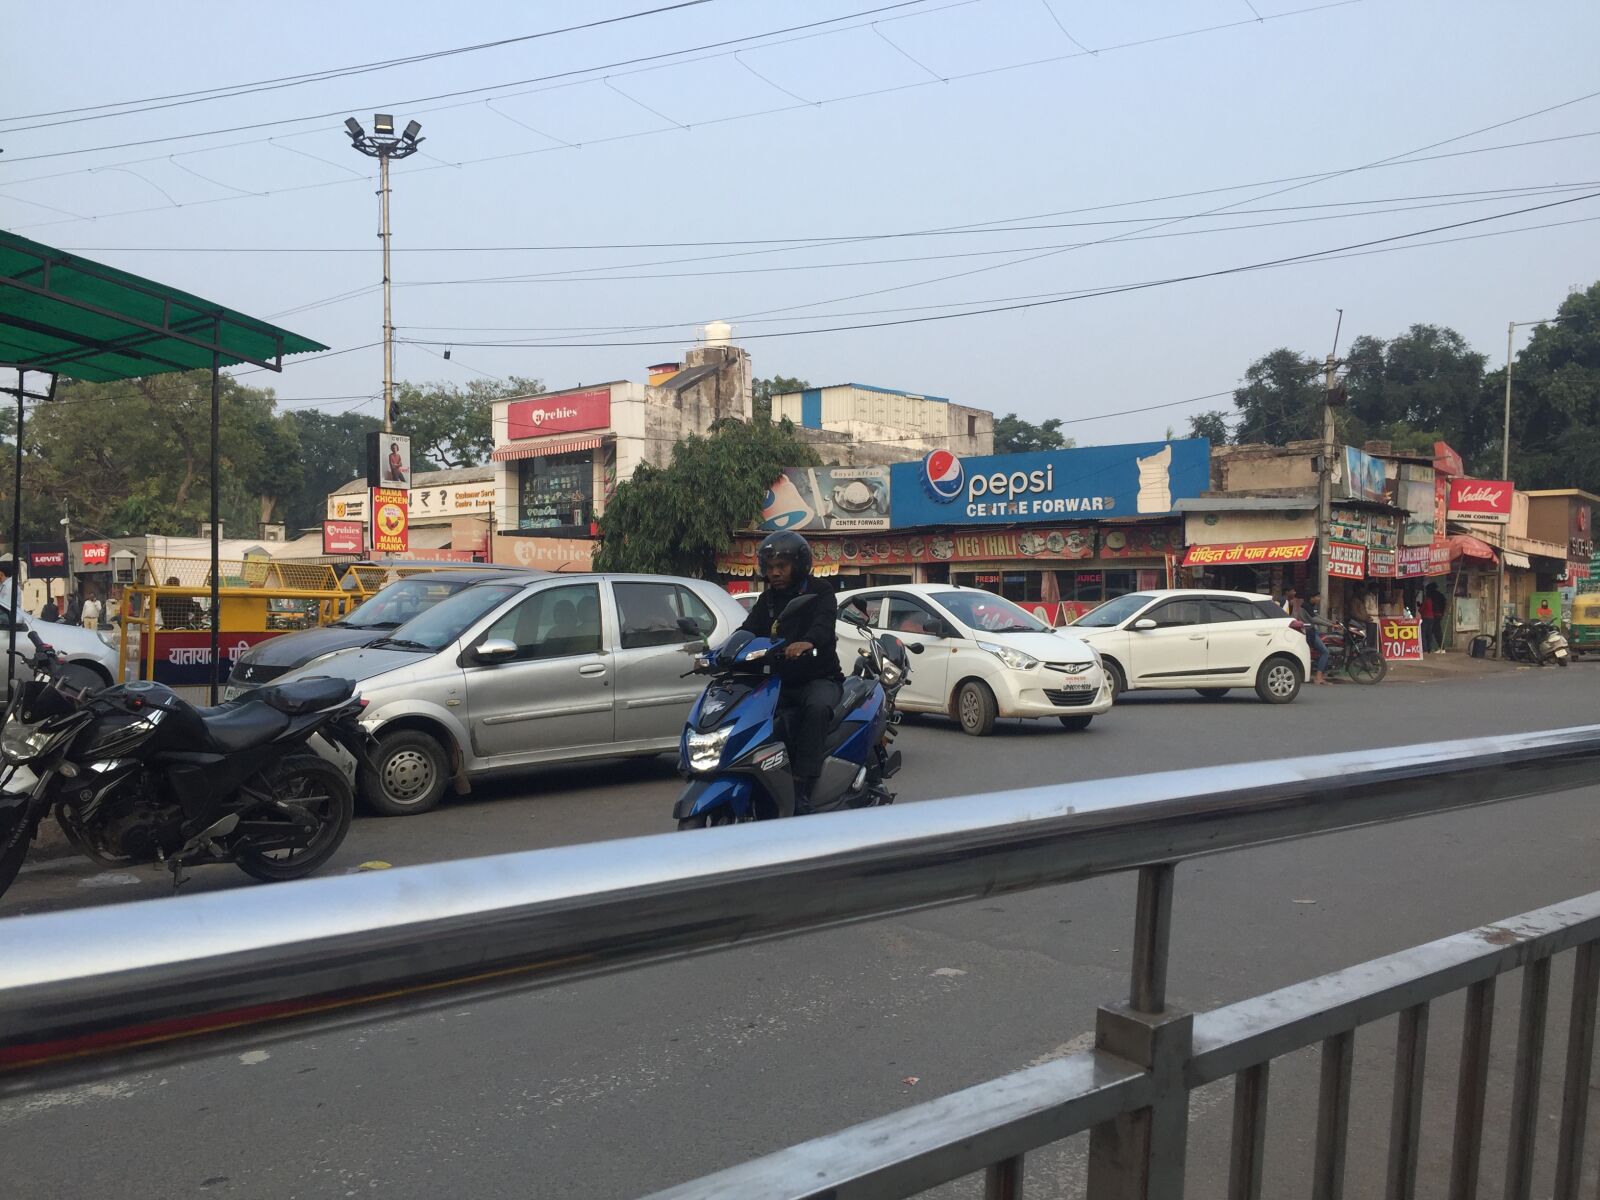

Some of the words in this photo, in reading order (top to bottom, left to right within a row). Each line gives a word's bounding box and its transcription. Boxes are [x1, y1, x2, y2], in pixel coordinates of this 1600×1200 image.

[968, 464, 1053, 502] pepsi
[375, 495, 408, 504] CHICKEN
[1457, 486, 1503, 507] Vadilal
[966, 500, 1028, 518] CENTRE
[376, 543, 406, 551] FRANKY
[957, 536, 980, 556] VEG
[982, 534, 1018, 556] THALI
[1226, 544, 1243, 560] जी
[1244, 547, 1267, 559] पान
[1327, 561, 1363, 576] PETHA
[975, 575, 1000, 583] FRESH
[1076, 574, 1102, 582] JUICE
[1383, 620, 1418, 640] पेठा
[761, 751, 788, 771] 125
